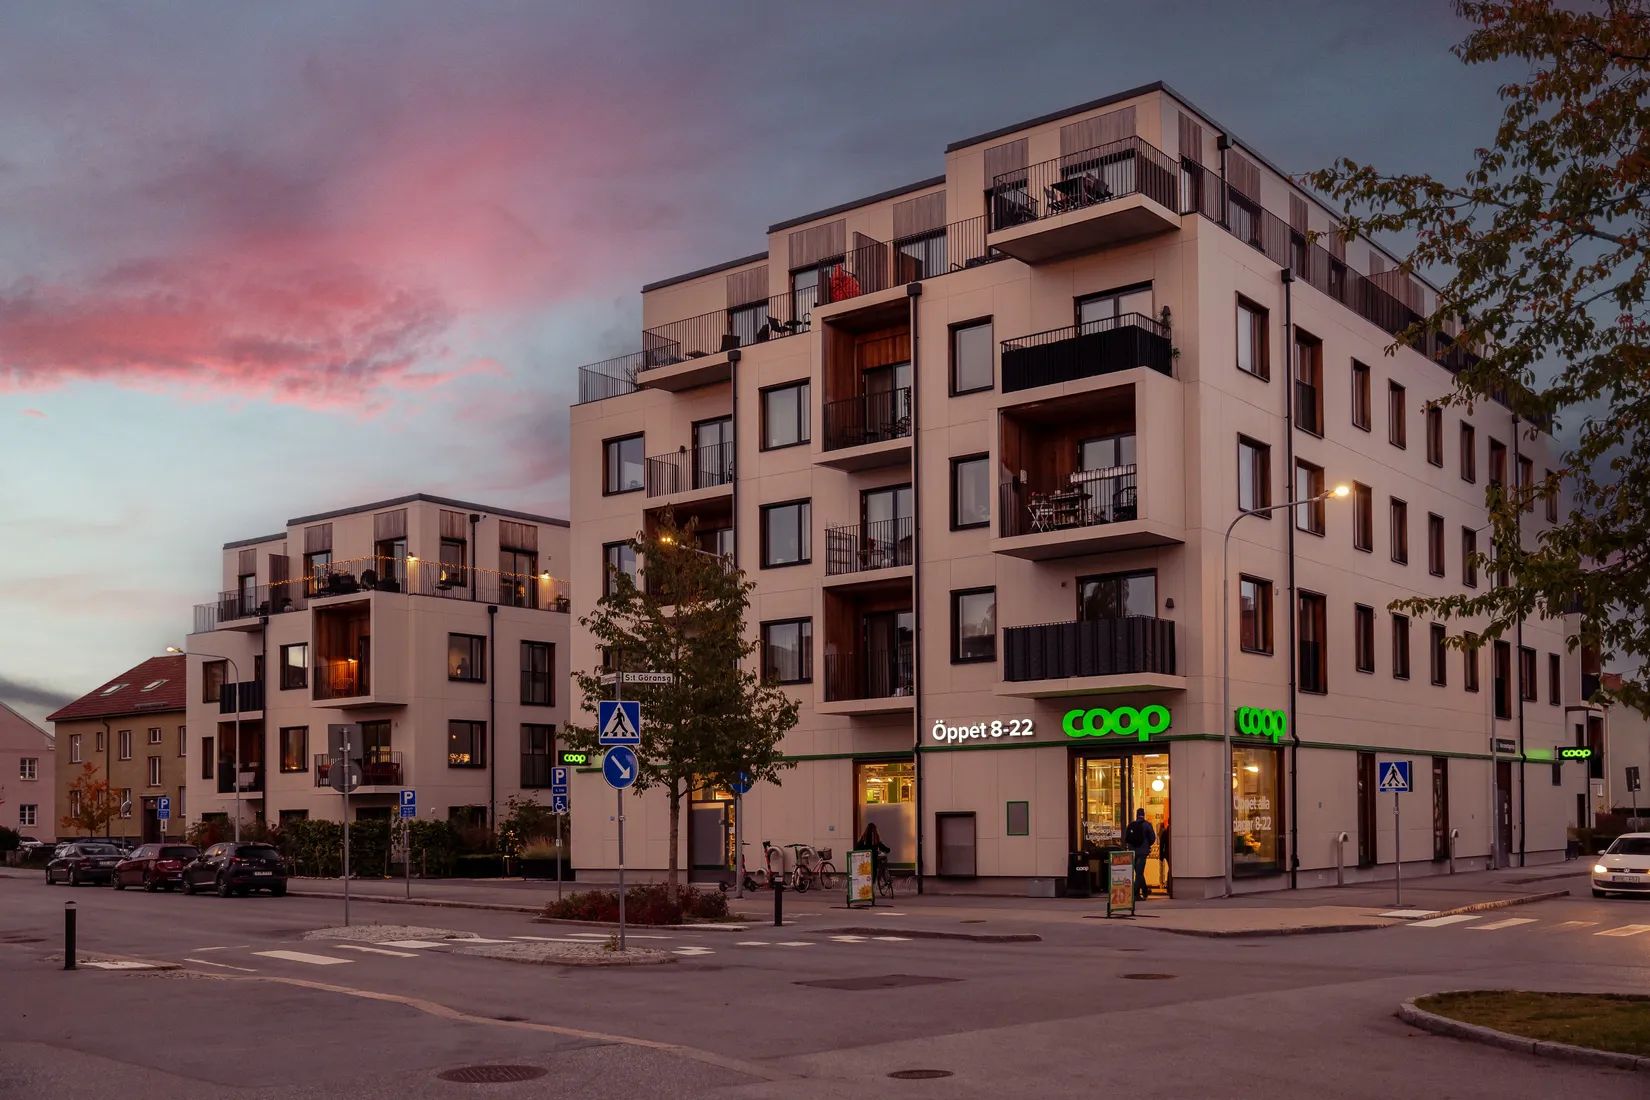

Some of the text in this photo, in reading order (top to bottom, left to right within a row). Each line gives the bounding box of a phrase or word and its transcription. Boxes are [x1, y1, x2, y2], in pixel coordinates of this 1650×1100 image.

[625, 674, 636, 682] S:t
[1062, 704, 1171, 742] coop
[1236, 706, 1287, 743] coop
[932, 719, 1033, 743] Öppet 8-22
[563, 754, 586, 764] coop
[1562, 749, 1591, 758] coop
[555, 769, 565, 784] P
[161, 798, 168, 809] P
[404, 791, 414, 804] P
[1255, 816, 1271, 830] 8-22
